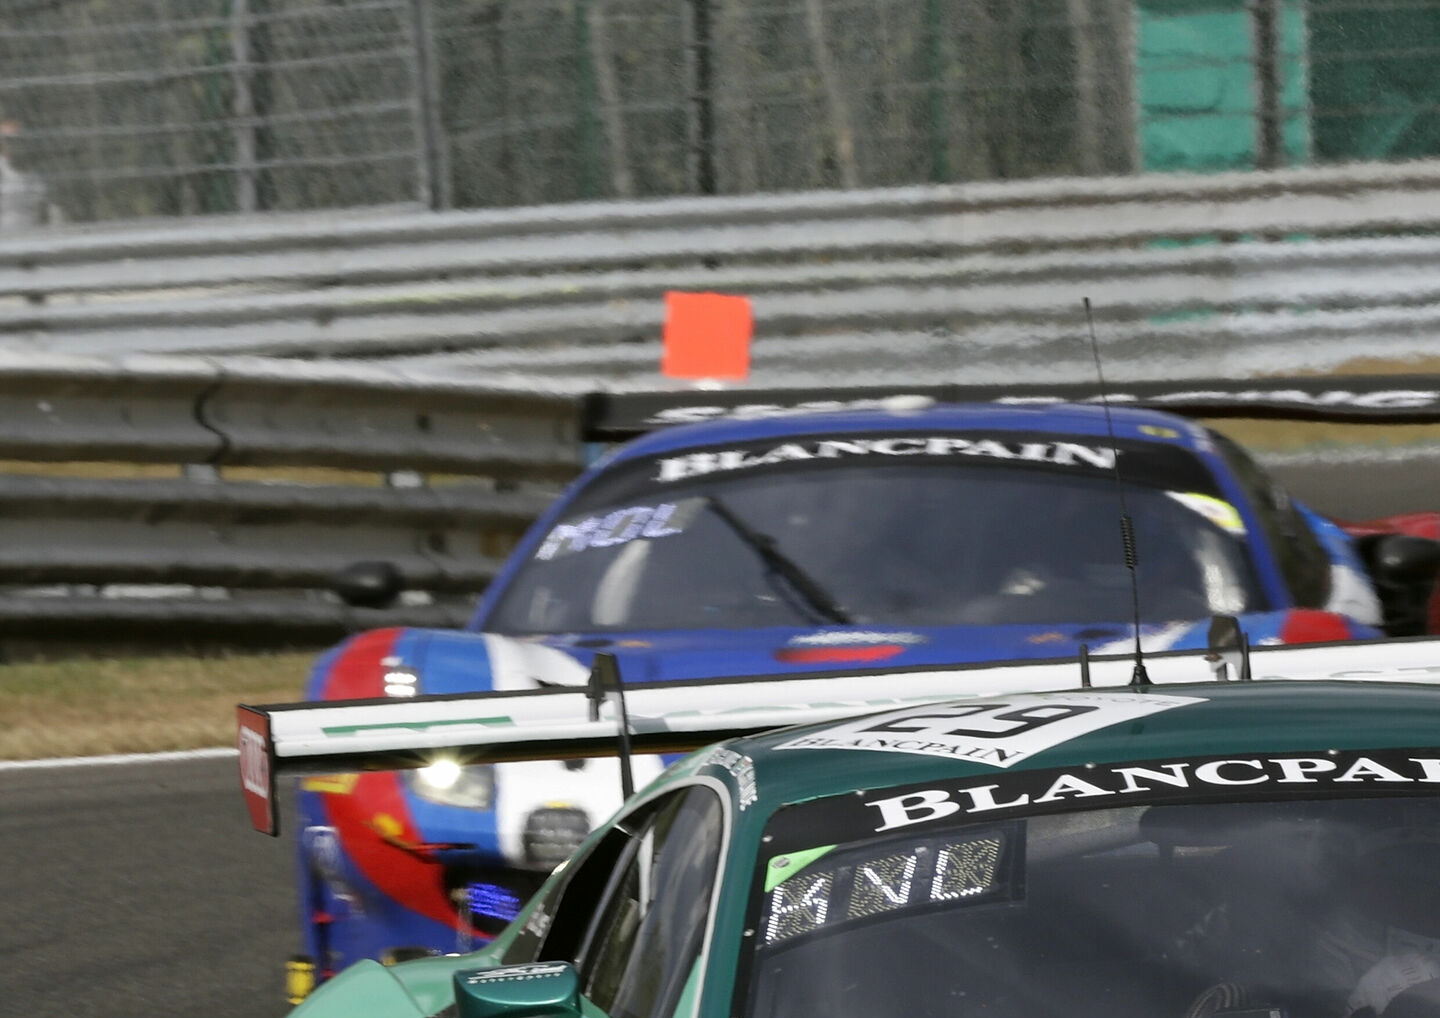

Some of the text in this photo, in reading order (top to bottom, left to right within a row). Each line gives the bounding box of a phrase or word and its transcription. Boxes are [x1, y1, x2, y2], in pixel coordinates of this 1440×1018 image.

[653, 437, 1124, 482] BLANCPAIN
[857, 703, 1099, 738] 29
[791, 737, 1025, 762] BLANCPAIN
